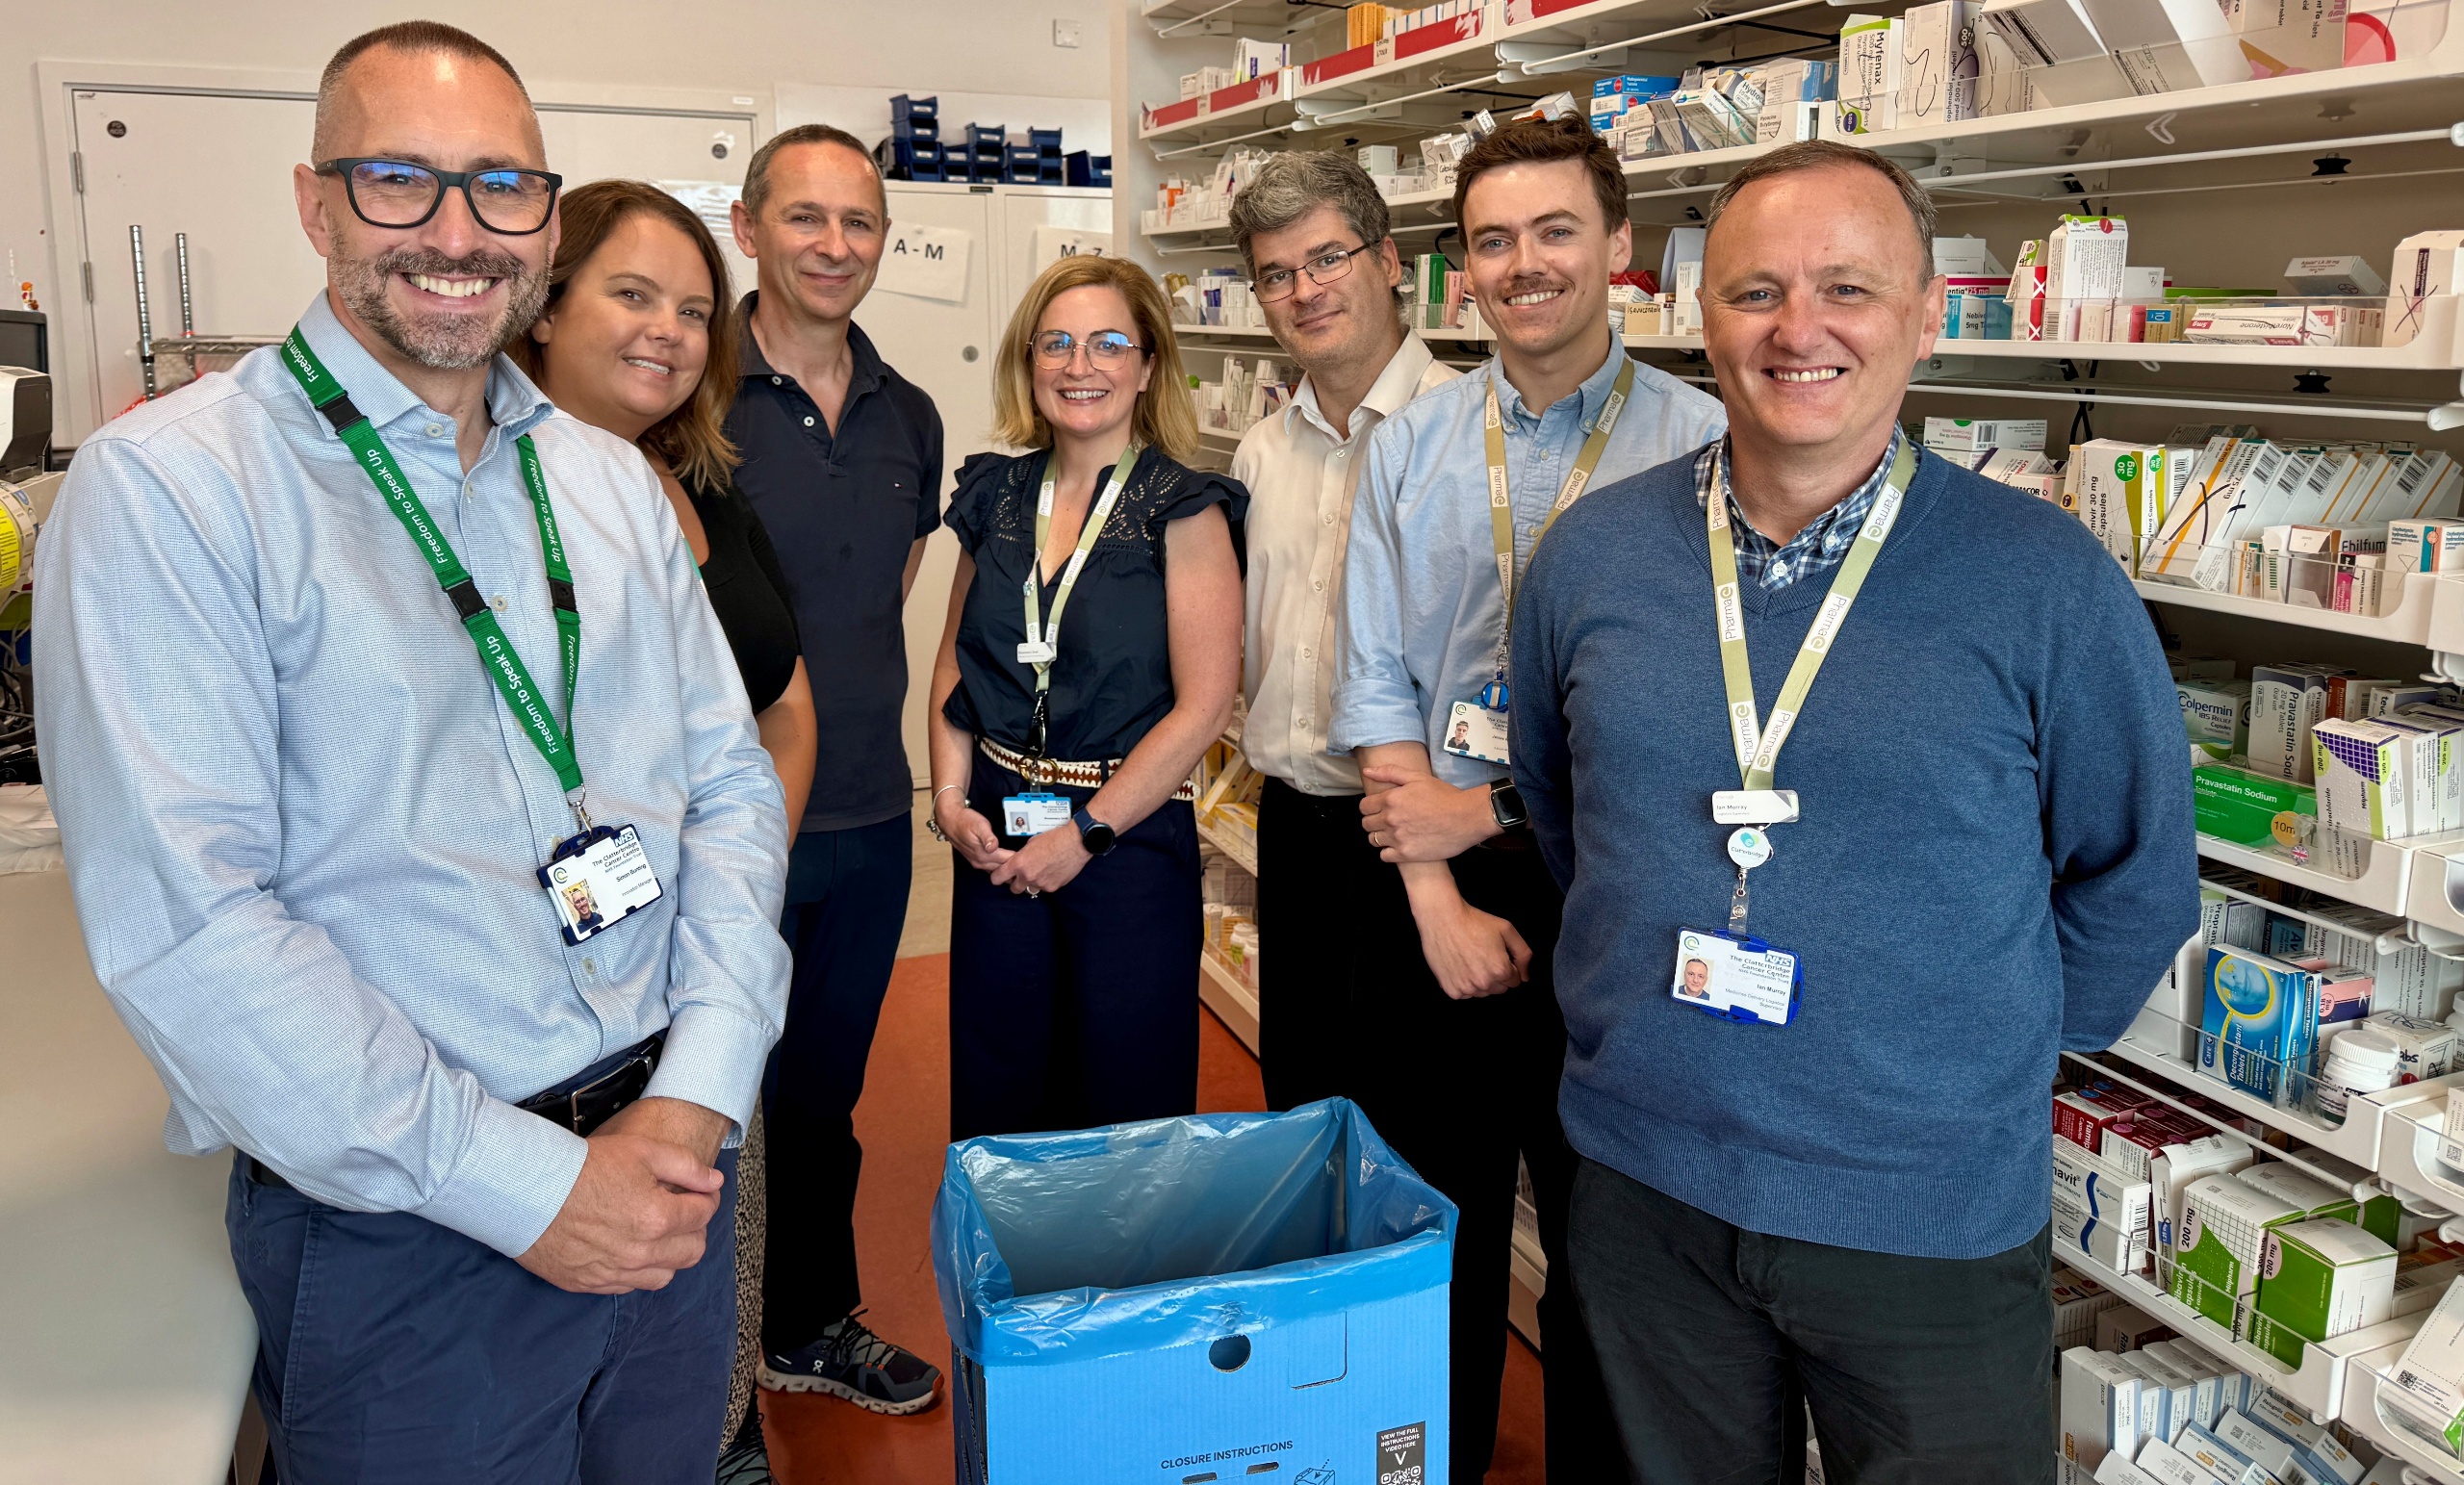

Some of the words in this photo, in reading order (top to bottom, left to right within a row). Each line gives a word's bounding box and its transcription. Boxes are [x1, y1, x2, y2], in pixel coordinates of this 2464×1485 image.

[1874, 32, 1885, 85] Myfenax
[893, 239, 907, 254] A
[925, 243, 943, 260] M
[286, 337, 295, 347] to
[290, 344, 319, 382] Freedom
[367, 448, 383, 468] Up
[2118, 462, 2125, 474] 30
[2126, 461, 2135, 477] mg
[377, 466, 405, 500] Speak
[527, 457, 545, 502] Freedom
[2091, 475, 2099, 492] mg
[2234, 476, 2243, 486] 75
[2090, 494, 2097, 505] 30
[2223, 487, 2235, 499] mg
[402, 500, 415, 514] to
[541, 503, 550, 515] to
[412, 514, 449, 564] Freedom
[543, 515, 558, 548] Speak
[551, 548, 561, 563] Up
[486, 635, 504, 657] Up
[566, 634, 576, 681] Freedom
[497, 654, 523, 690] Speak
[517, 689, 529, 705] to
[2280, 690, 2287, 699] 20
[2178, 692, 2233, 717] Colpermin
[2279, 701, 2286, 710] mg
[526, 700, 559, 755] Freedom
[2210, 722, 2232, 730] Capsules
[2286, 691, 2299, 752] Pravastatin
[2318, 744, 2325, 756] mg
[2195, 775, 2243, 795] Pravastatin
[2245, 788, 2278, 804] Sodium
[615, 831, 635, 847] NHS
[592, 858, 603, 867] The
[1744, 958, 1790, 974] Clatterbridge
[1765, 953, 1792, 968] NHS
[1741, 963, 1765, 974] Cancer
[1767, 970, 1790, 979] Centre
[1767, 986, 1786, 996] Murray
[2230, 1024, 2244, 1080] Decongestant
[2237, 1054, 2246, 1082] Tablets
[2083, 1120, 2094, 1150] Ramip
[2182, 1226, 2192, 1249] 200
[2187, 1207, 2195, 1225] mg
[2270, 1243, 2278, 1259] mg
[2225, 1261, 2235, 1293] Milpharm
[1381, 1432, 1395, 1441] VIEW
[1381, 1434, 1420, 1447] INSTRUCTIONS
[1161, 1452, 1212, 1470] CLOSURE
[1214, 1440, 1294, 1461] INSTRUCTIONS
[1385, 1444, 1402, 1452] VIDEO
